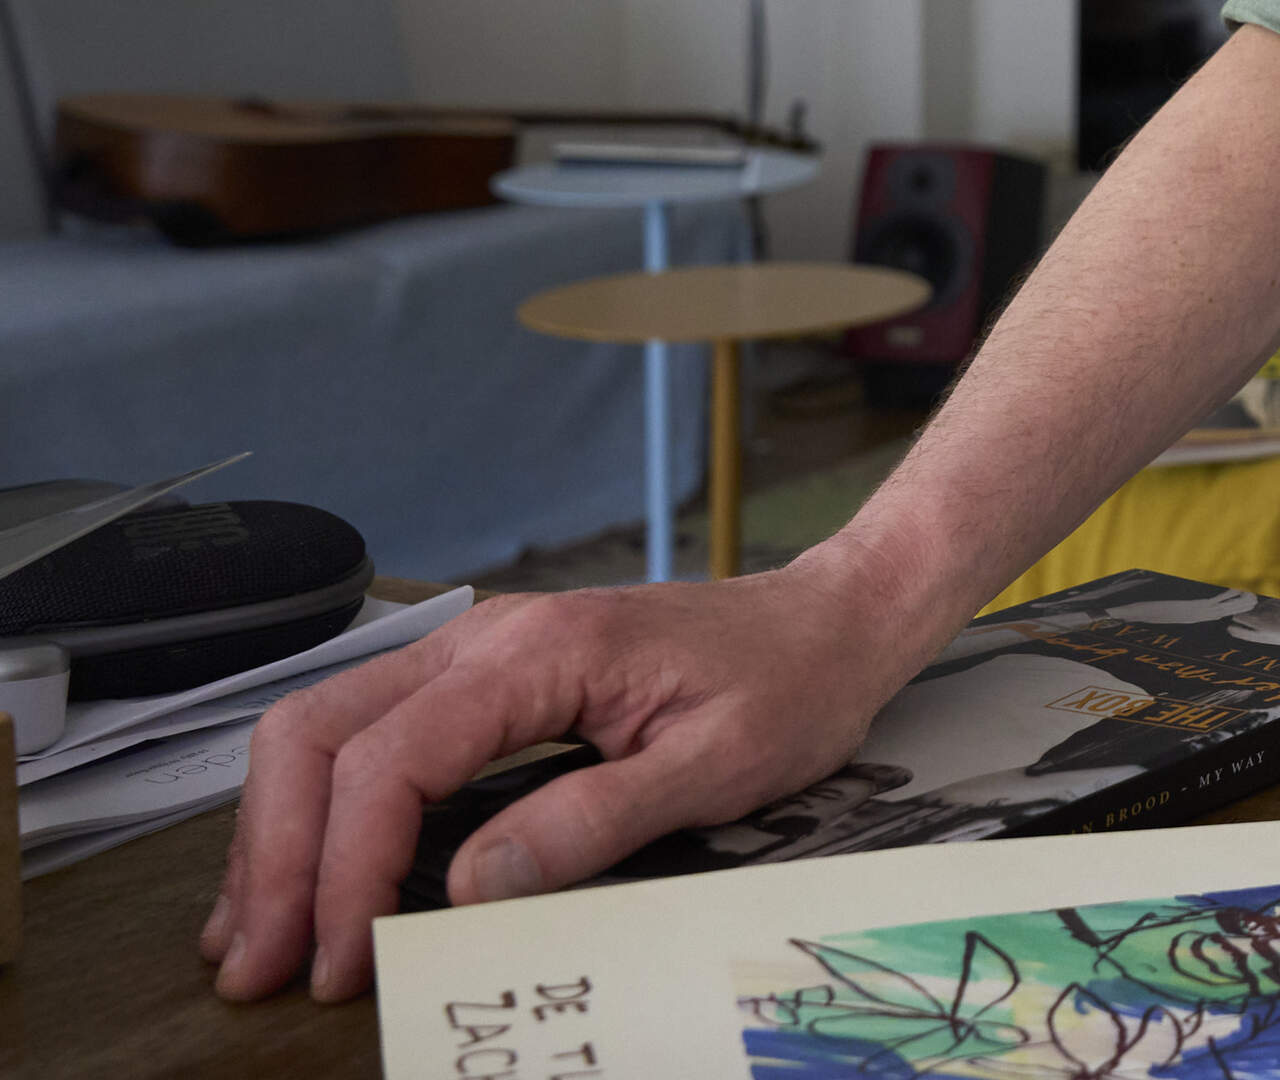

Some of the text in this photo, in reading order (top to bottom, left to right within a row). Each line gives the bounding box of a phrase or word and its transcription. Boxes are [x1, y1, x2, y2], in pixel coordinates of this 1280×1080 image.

[1065, 689, 1230, 729] THE BOX
[1105, 791, 1171, 828] BROOD
[1199, 768, 1224, 788] MY
[1232, 750, 1266, 776] WAY
[532, 975, 592, 1022] DE
